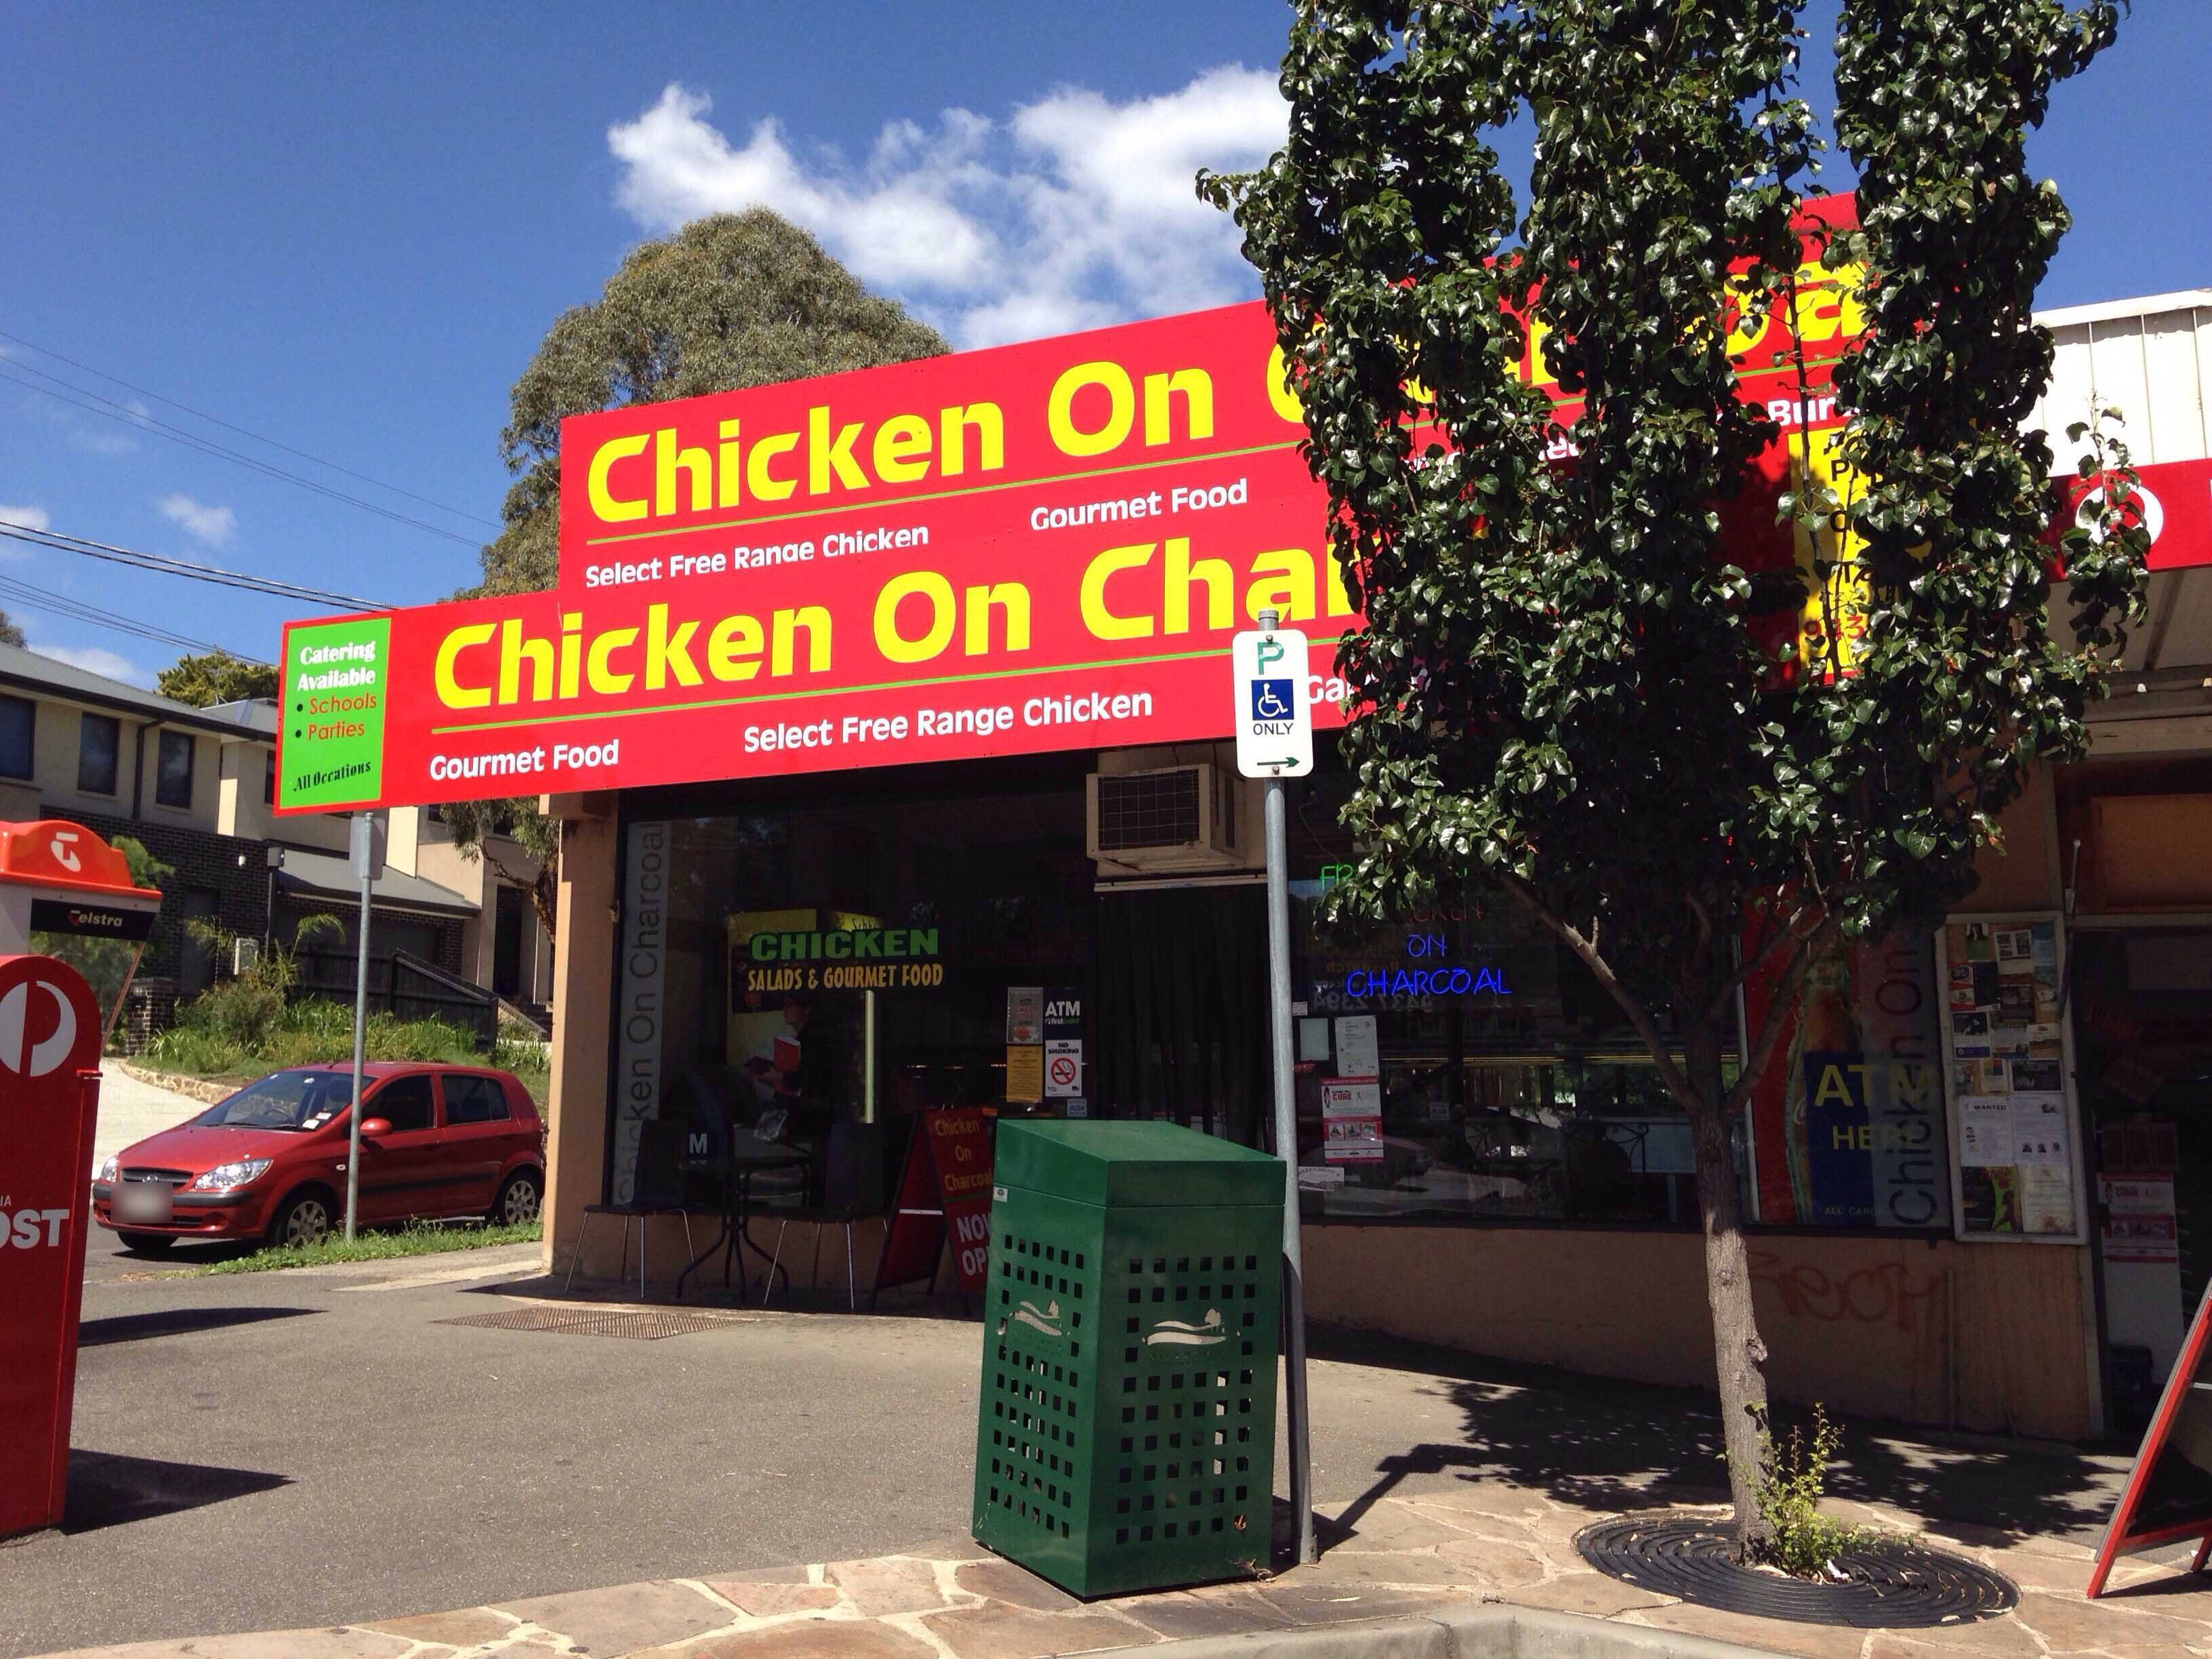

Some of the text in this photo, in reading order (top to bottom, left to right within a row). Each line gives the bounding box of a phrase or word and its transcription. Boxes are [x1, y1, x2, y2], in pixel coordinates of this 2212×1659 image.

[588, 361, 1214, 523] Chicken On
[1030, 478, 1248, 531] Gourmet Food
[586, 526, 928, 588] Select Free Range Chicken
[300, 640, 376, 665] Catering
[435, 603, 832, 709] Chicken
[874, 571, 1030, 662] On
[1257, 642, 1284, 675] P
[297, 667, 376, 691] Available
[309, 693, 377, 715] Schools
[308, 720, 365, 741] Parties
[744, 692, 1152, 753] Select Free Range Chicken
[1252, 722, 1294, 735] ONLY
[430, 739, 619, 781] Gourmet Food
[293, 761, 371, 792] All Occations
[68, 909, 123, 927] Telstra
[749, 927, 940, 962] CHICKEN
[1408, 933, 1448, 958] ON
[747, 962, 944, 992] SALADS & GOURMET FOOD
[1346, 966, 1513, 997] CHARCOAL
[626, 991, 656, 1045] On
[1045, 1000, 1081, 1017] ATM
[935, 1118, 981, 1136] Chicken
[954, 1144, 972, 1162] On
